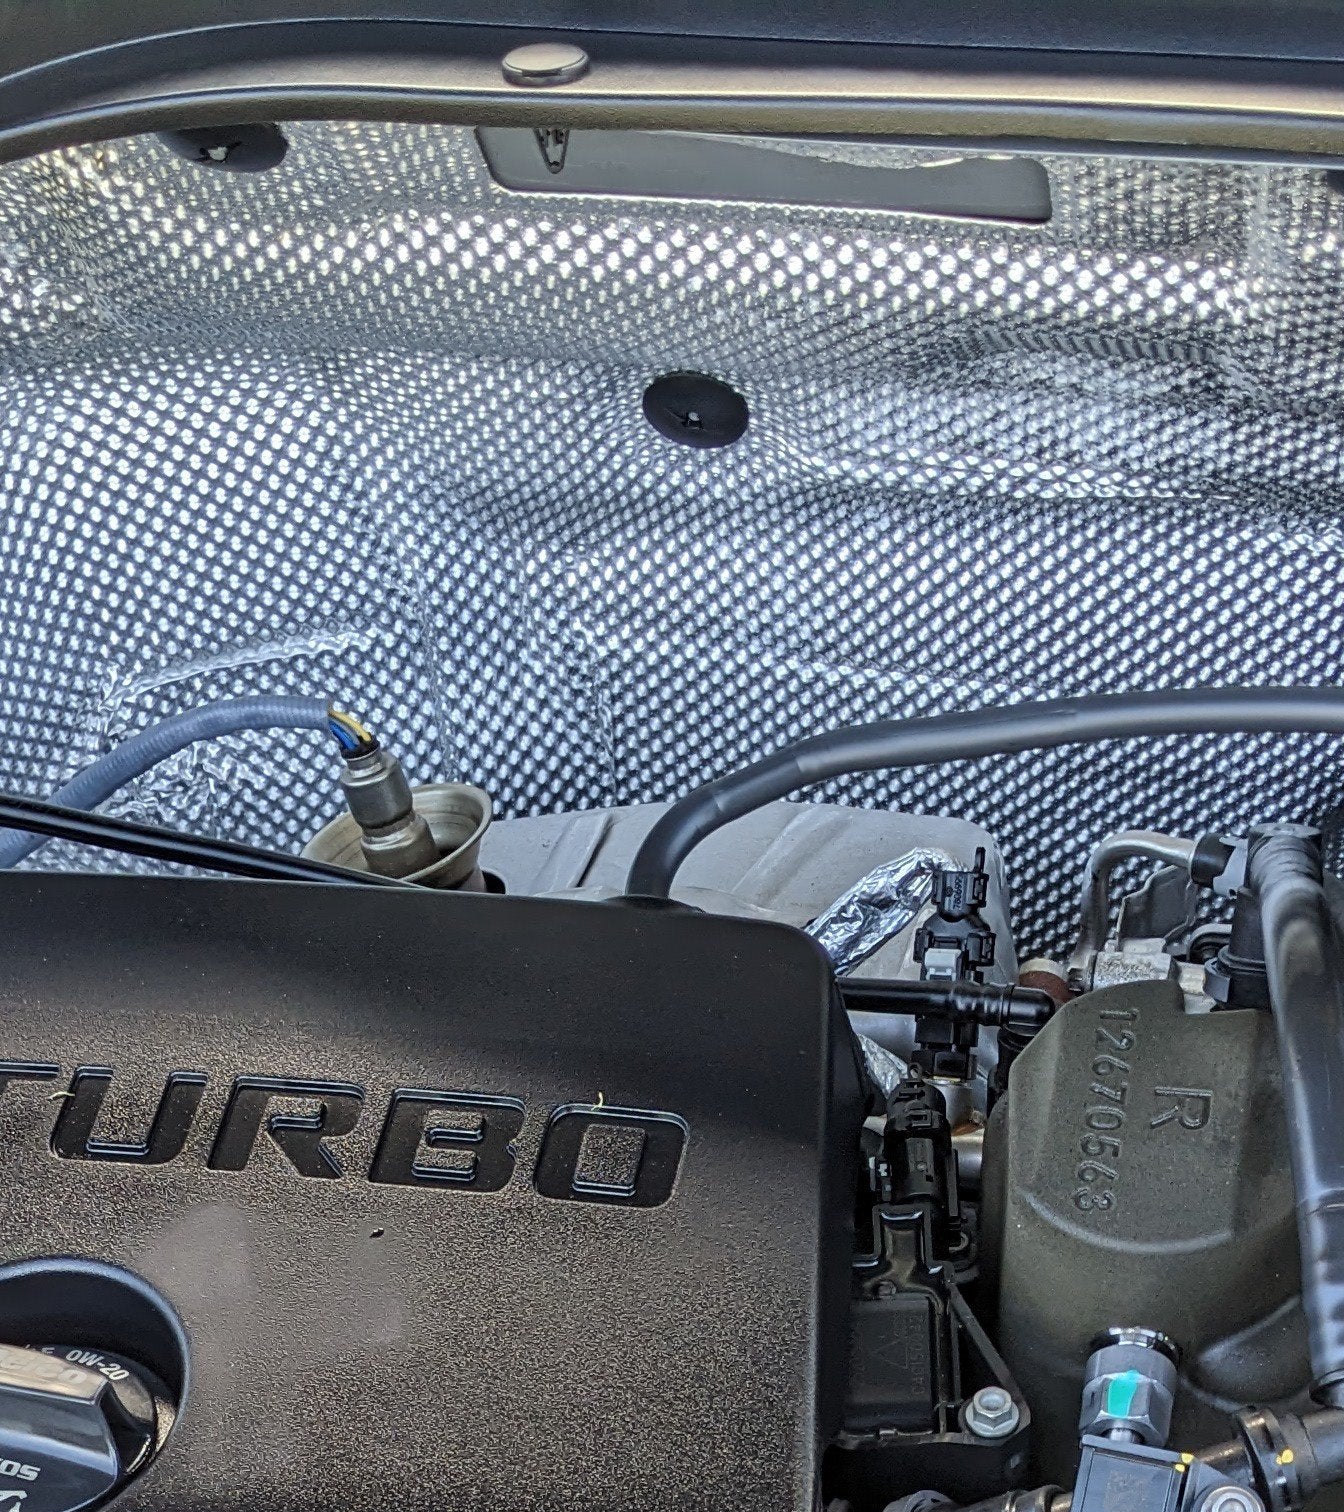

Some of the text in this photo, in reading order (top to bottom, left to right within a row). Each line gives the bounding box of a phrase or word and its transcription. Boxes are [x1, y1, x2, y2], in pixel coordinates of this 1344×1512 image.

[1074, 1008, 1140, 1211] 12670563
[1150, 1086, 1213, 1130] R
[66, 1349, 130, 1381] 0W-20
